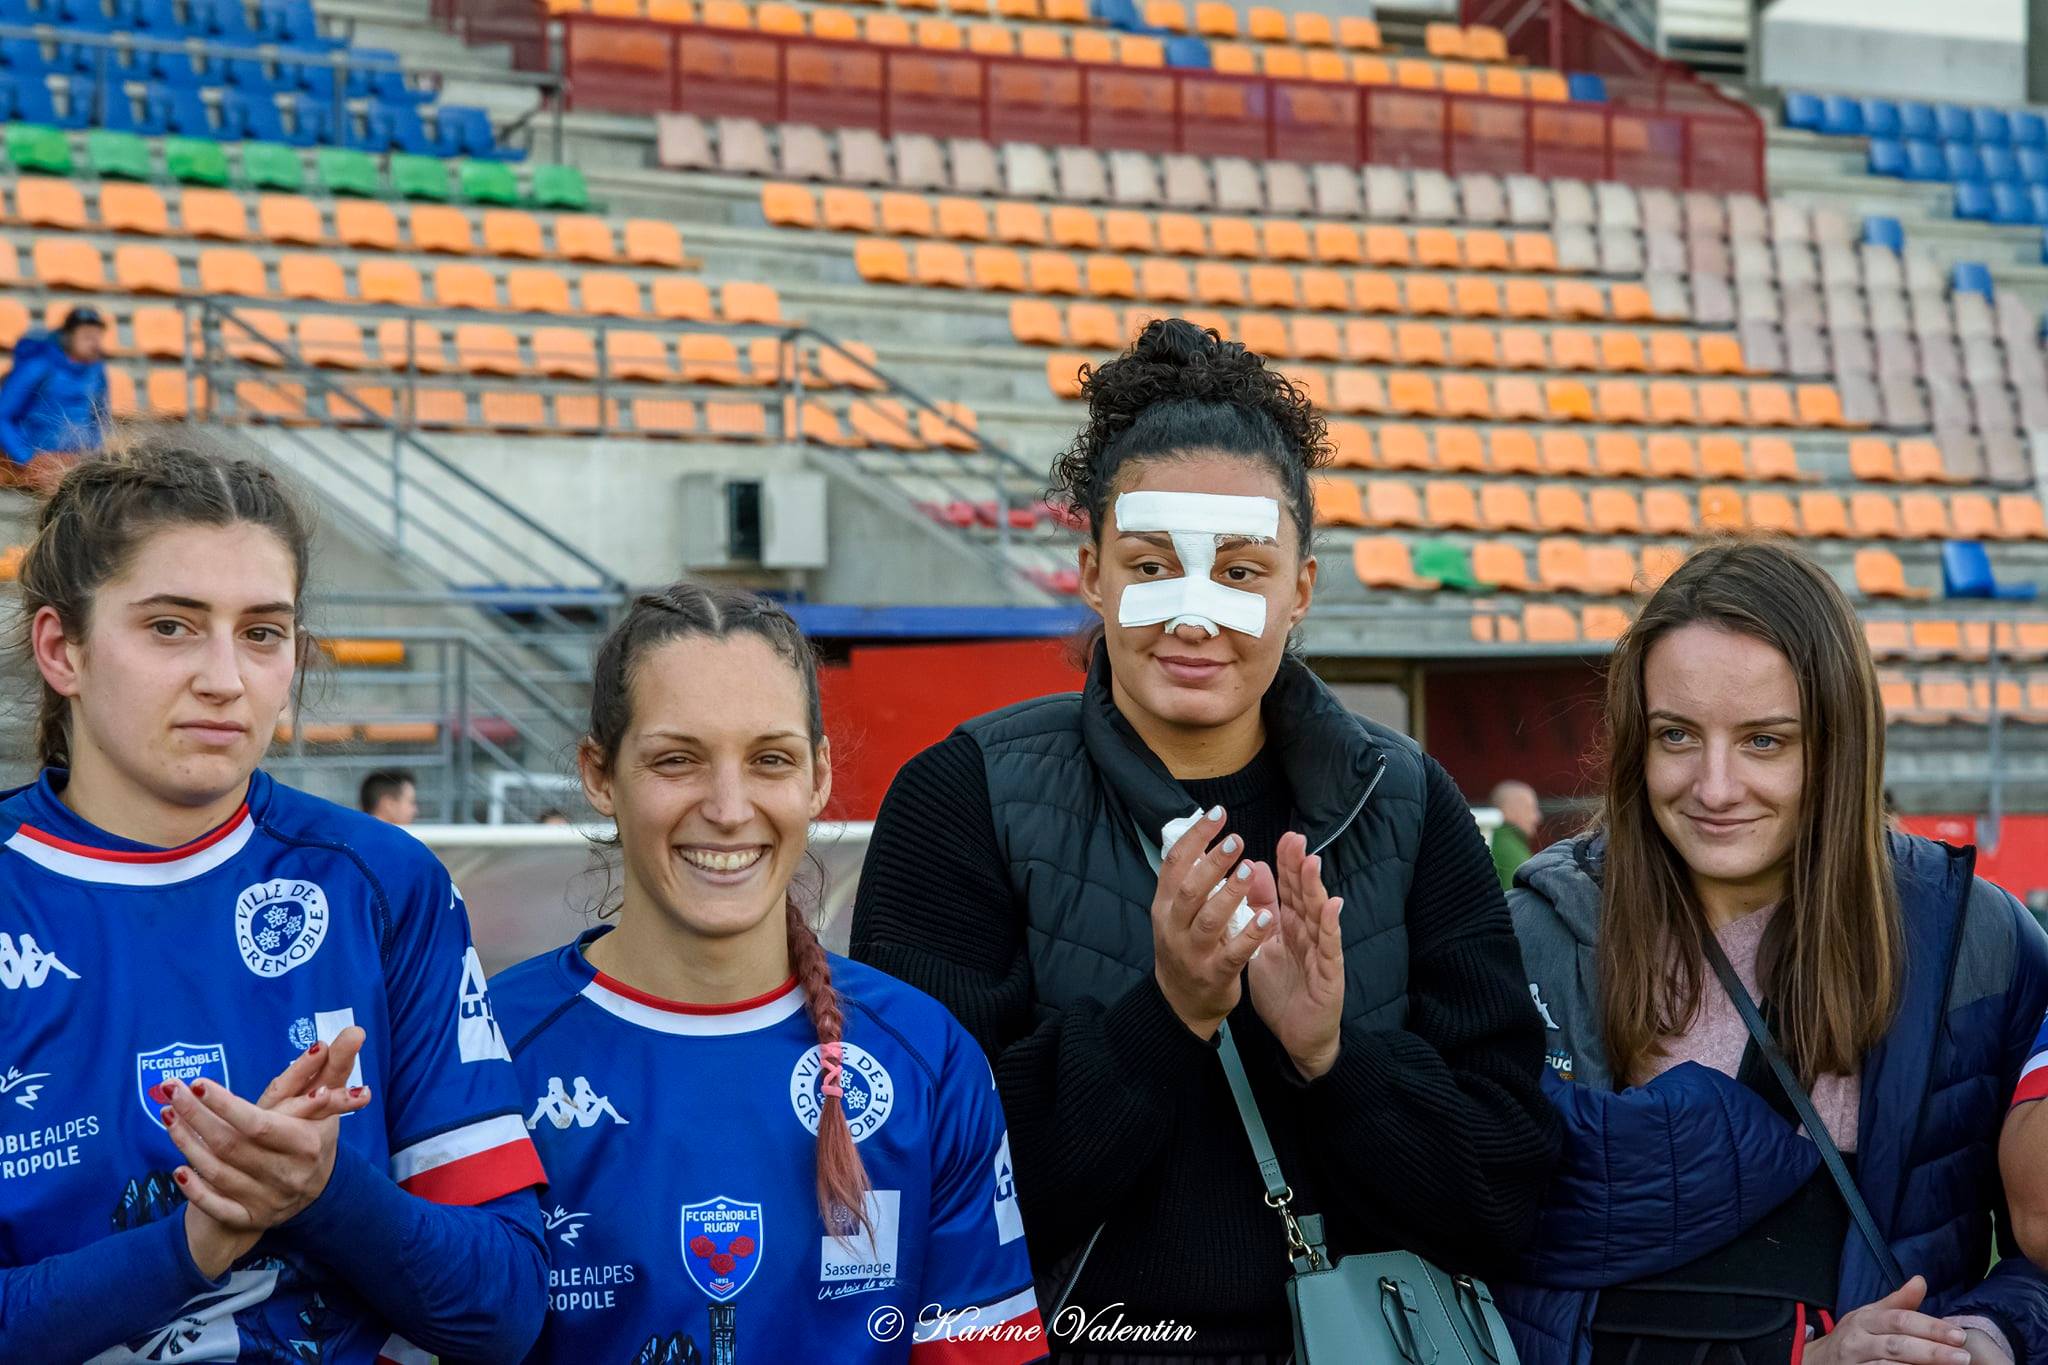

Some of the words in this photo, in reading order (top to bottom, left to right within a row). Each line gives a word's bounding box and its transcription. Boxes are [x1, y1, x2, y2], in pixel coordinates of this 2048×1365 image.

[238, 884, 282, 919] VILLE
[290, 884, 316, 901] DE
[240, 909, 324, 972] GRENOBLE
[162, 1066, 202, 1080] RUGBY
[857, 1055, 883, 1083] DE
[797, 1092, 889, 1138] GROBLE
[704, 1222, 740, 1233] RUGBY
[825, 1262, 892, 1277] Sassenage
[834, 1281, 861, 1296] choix
[862, 1278, 876, 1291] de
